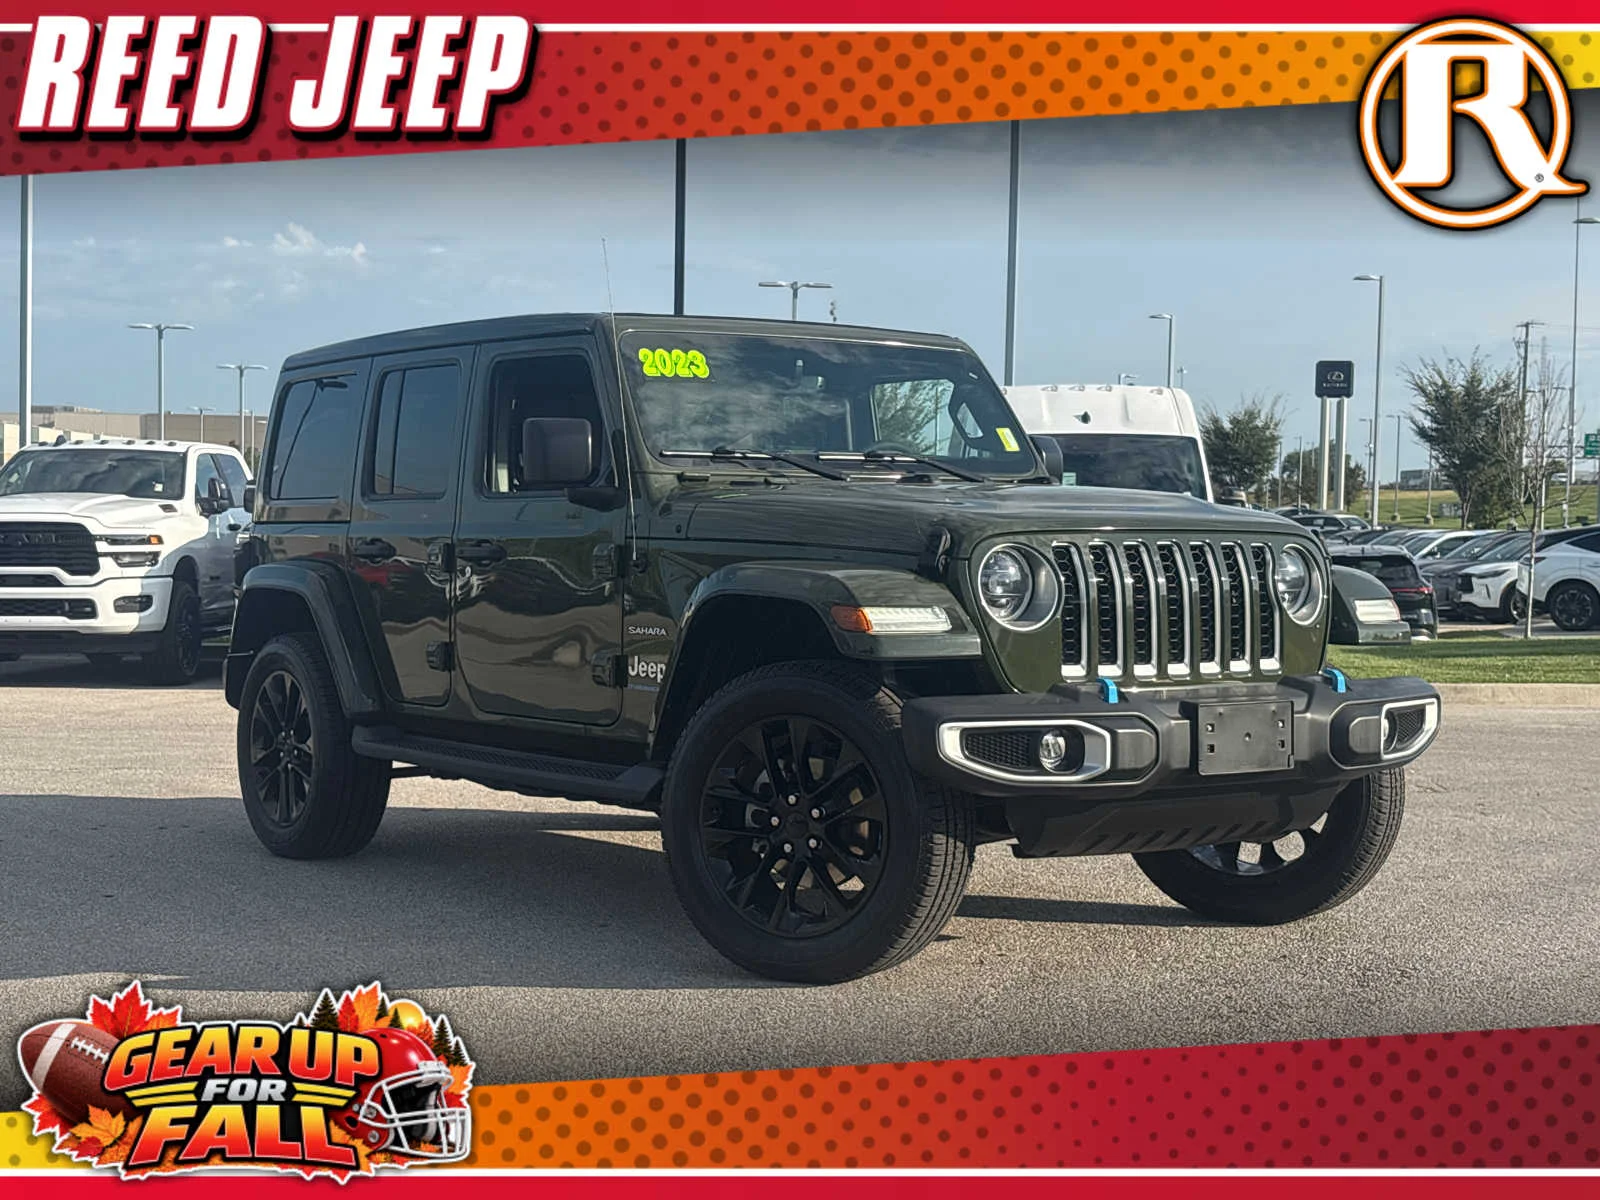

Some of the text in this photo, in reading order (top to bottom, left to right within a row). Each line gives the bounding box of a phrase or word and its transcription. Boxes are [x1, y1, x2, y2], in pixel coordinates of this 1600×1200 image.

[638, 347, 710, 378] 2023
[628, 626, 666, 636] SAHARA
[627, 655, 666, 684] Jeep
